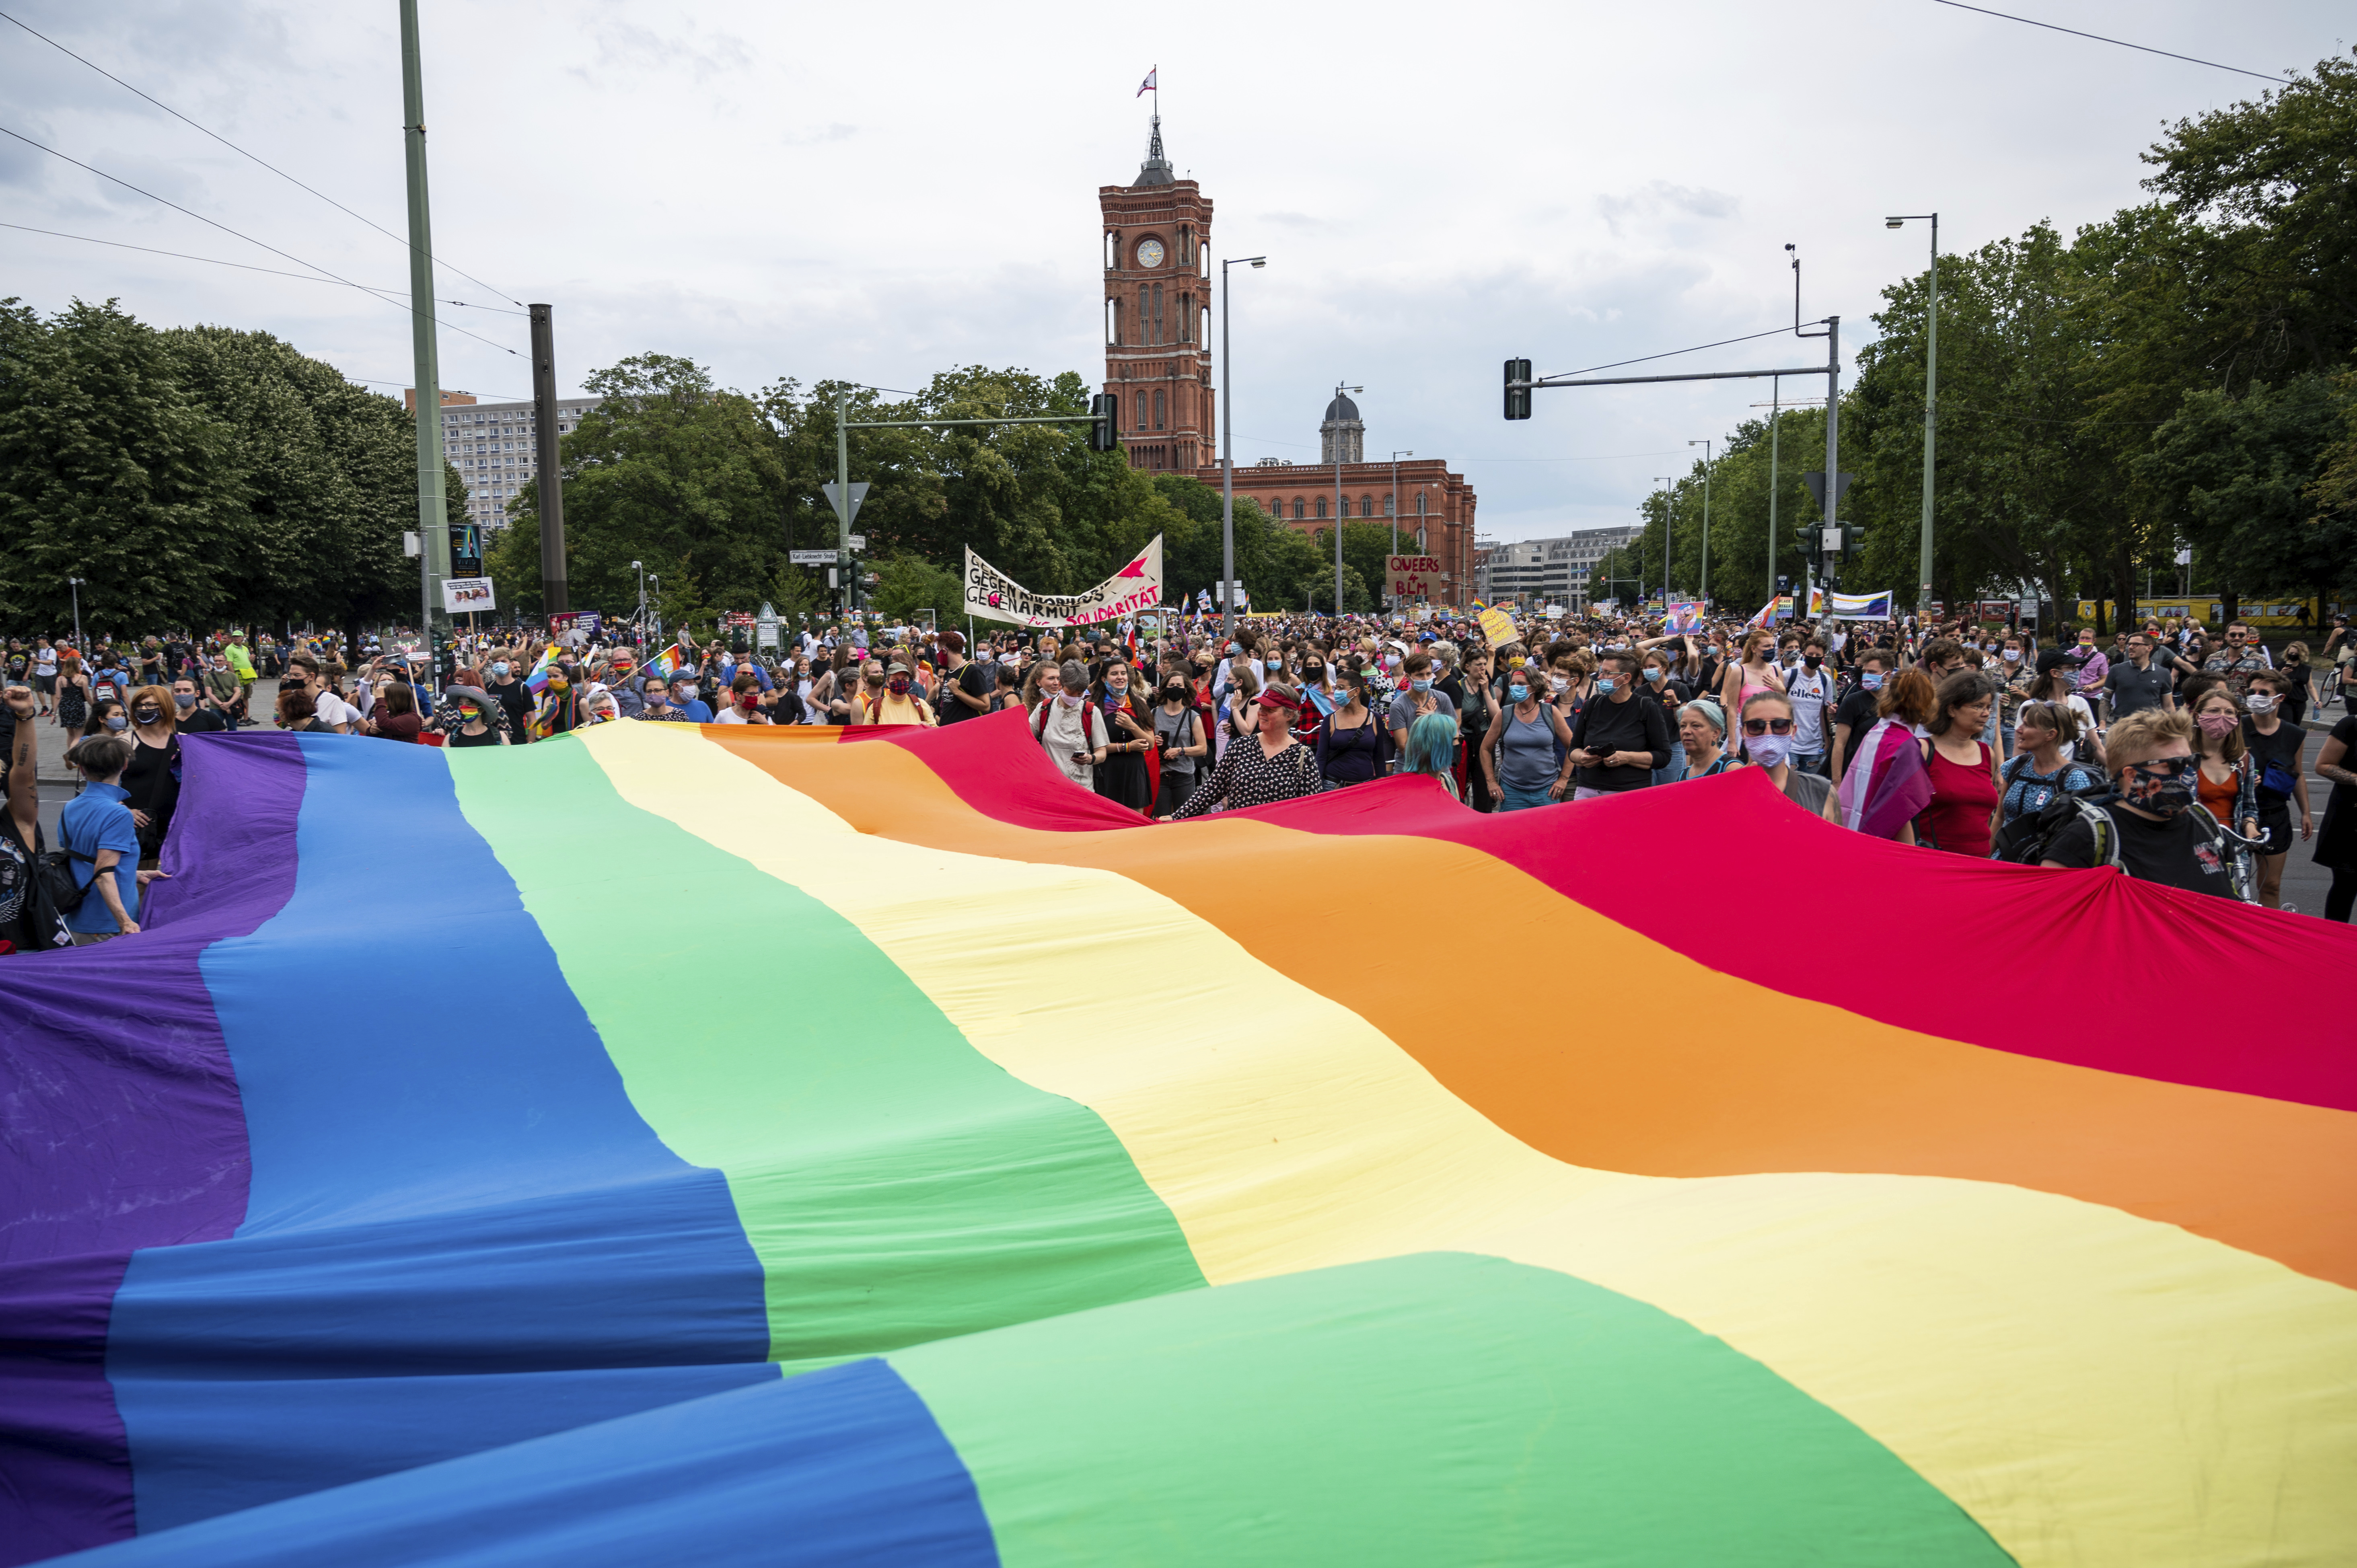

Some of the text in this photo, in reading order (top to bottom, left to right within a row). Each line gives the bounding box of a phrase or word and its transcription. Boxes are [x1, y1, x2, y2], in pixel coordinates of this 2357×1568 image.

[1390, 557, 1439, 573] QUEERS
[1408, 572, 1419, 584] 4
[1396, 580, 1428, 595] BLM
[1485, 620, 1507, 638] HUMAN
[1493, 624, 1516, 643] RIGHTS
[1791, 688, 1823, 700] elless
